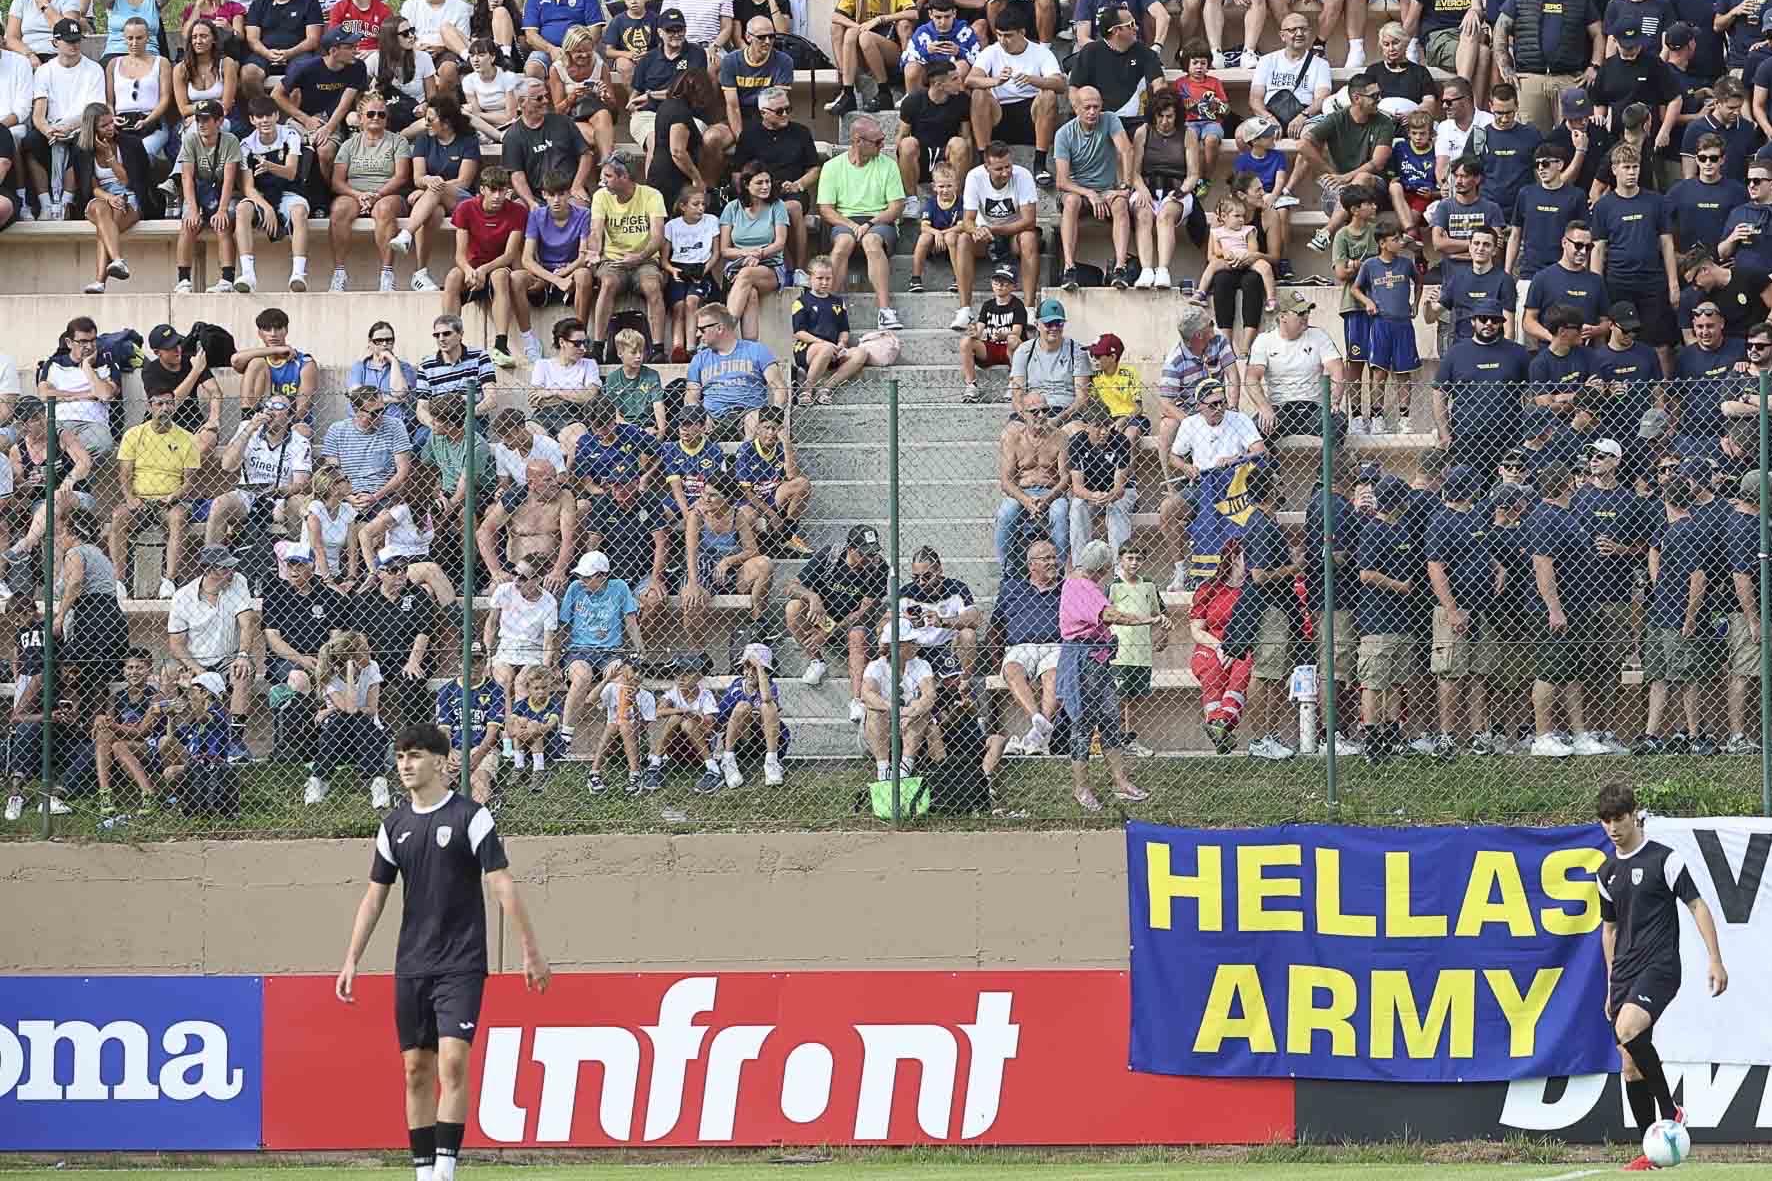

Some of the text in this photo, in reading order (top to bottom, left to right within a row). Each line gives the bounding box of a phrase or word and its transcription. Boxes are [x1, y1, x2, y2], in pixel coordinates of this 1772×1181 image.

[1146, 841, 1605, 939] HELLAS
[479, 976, 1020, 1143] infront
[1193, 963, 1564, 1059] ARMY
